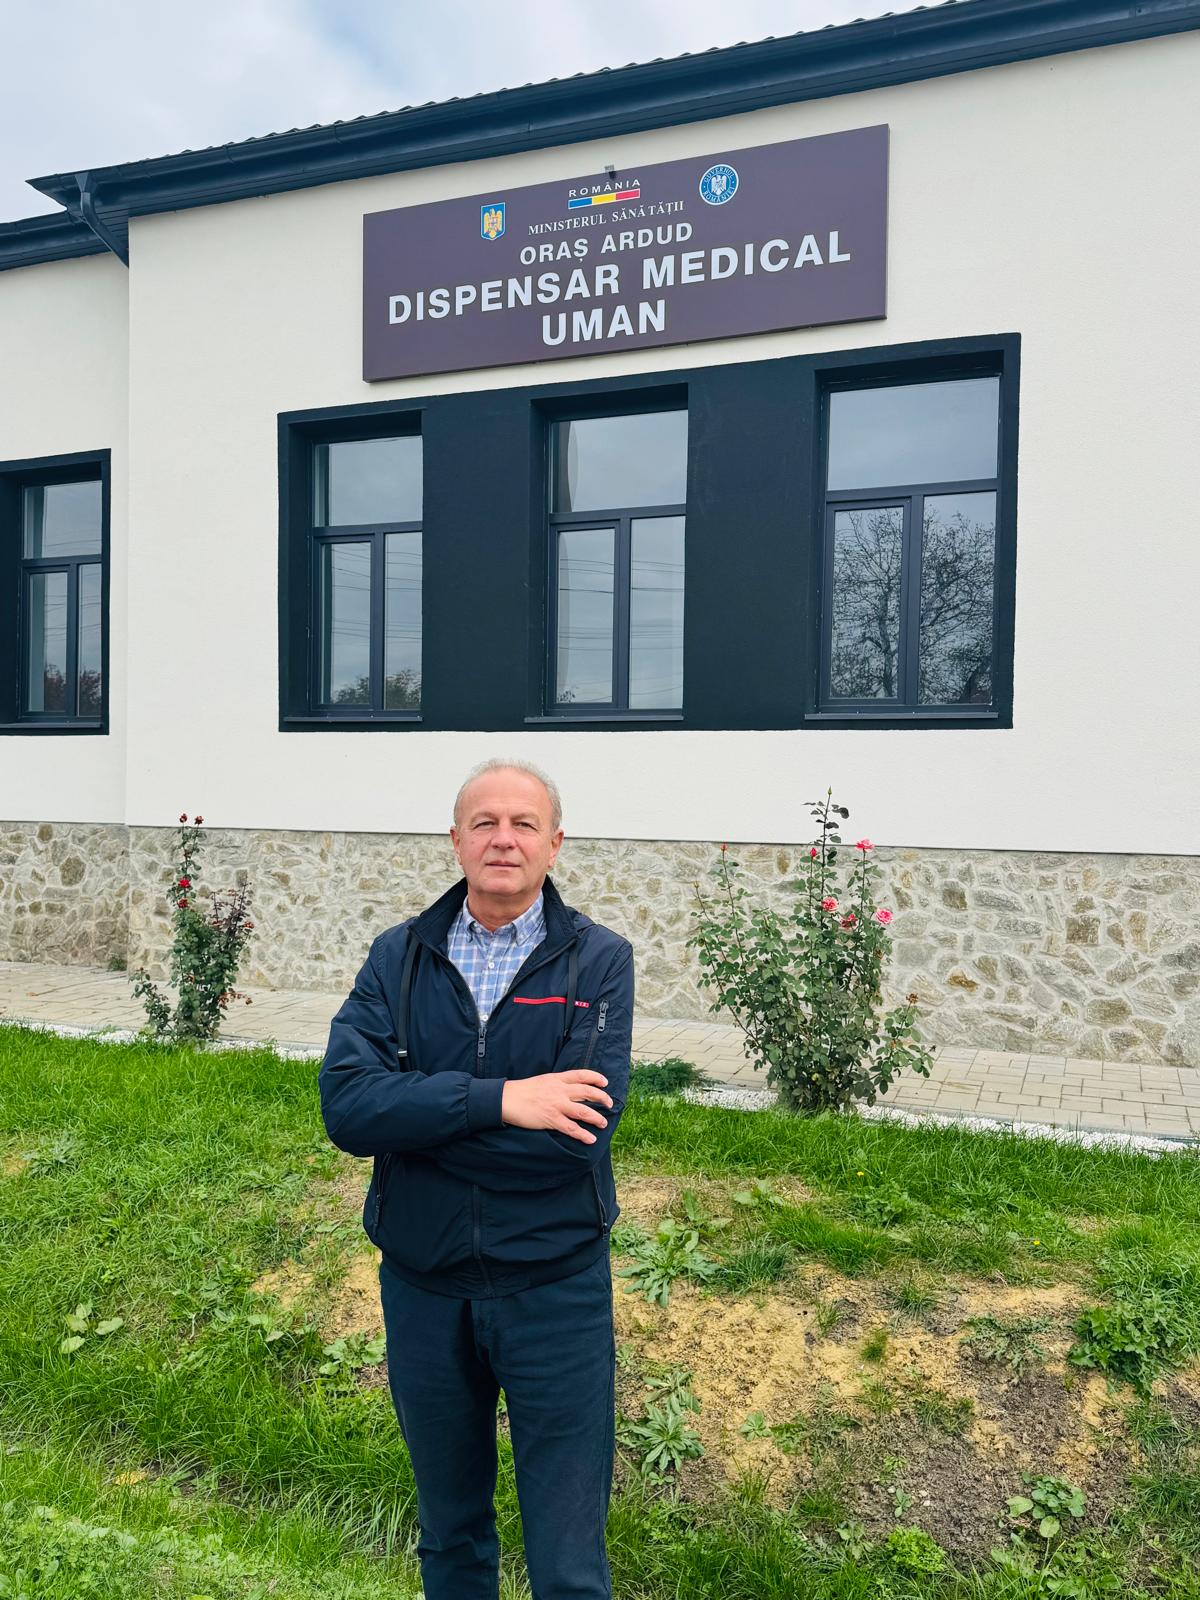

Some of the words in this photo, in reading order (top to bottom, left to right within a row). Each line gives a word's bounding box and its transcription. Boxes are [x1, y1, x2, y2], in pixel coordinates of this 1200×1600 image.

[568, 179, 641, 197] ROMÂNIA
[519, 238, 589, 265] ORAȘ
[601, 222, 693, 253] ARDUD
[528, 214, 607, 236] MINISTERUL
[388, 263, 620, 325] DISPENSAR
[643, 230, 851, 290] MEDICAL
[541, 299, 667, 346] UMAN
